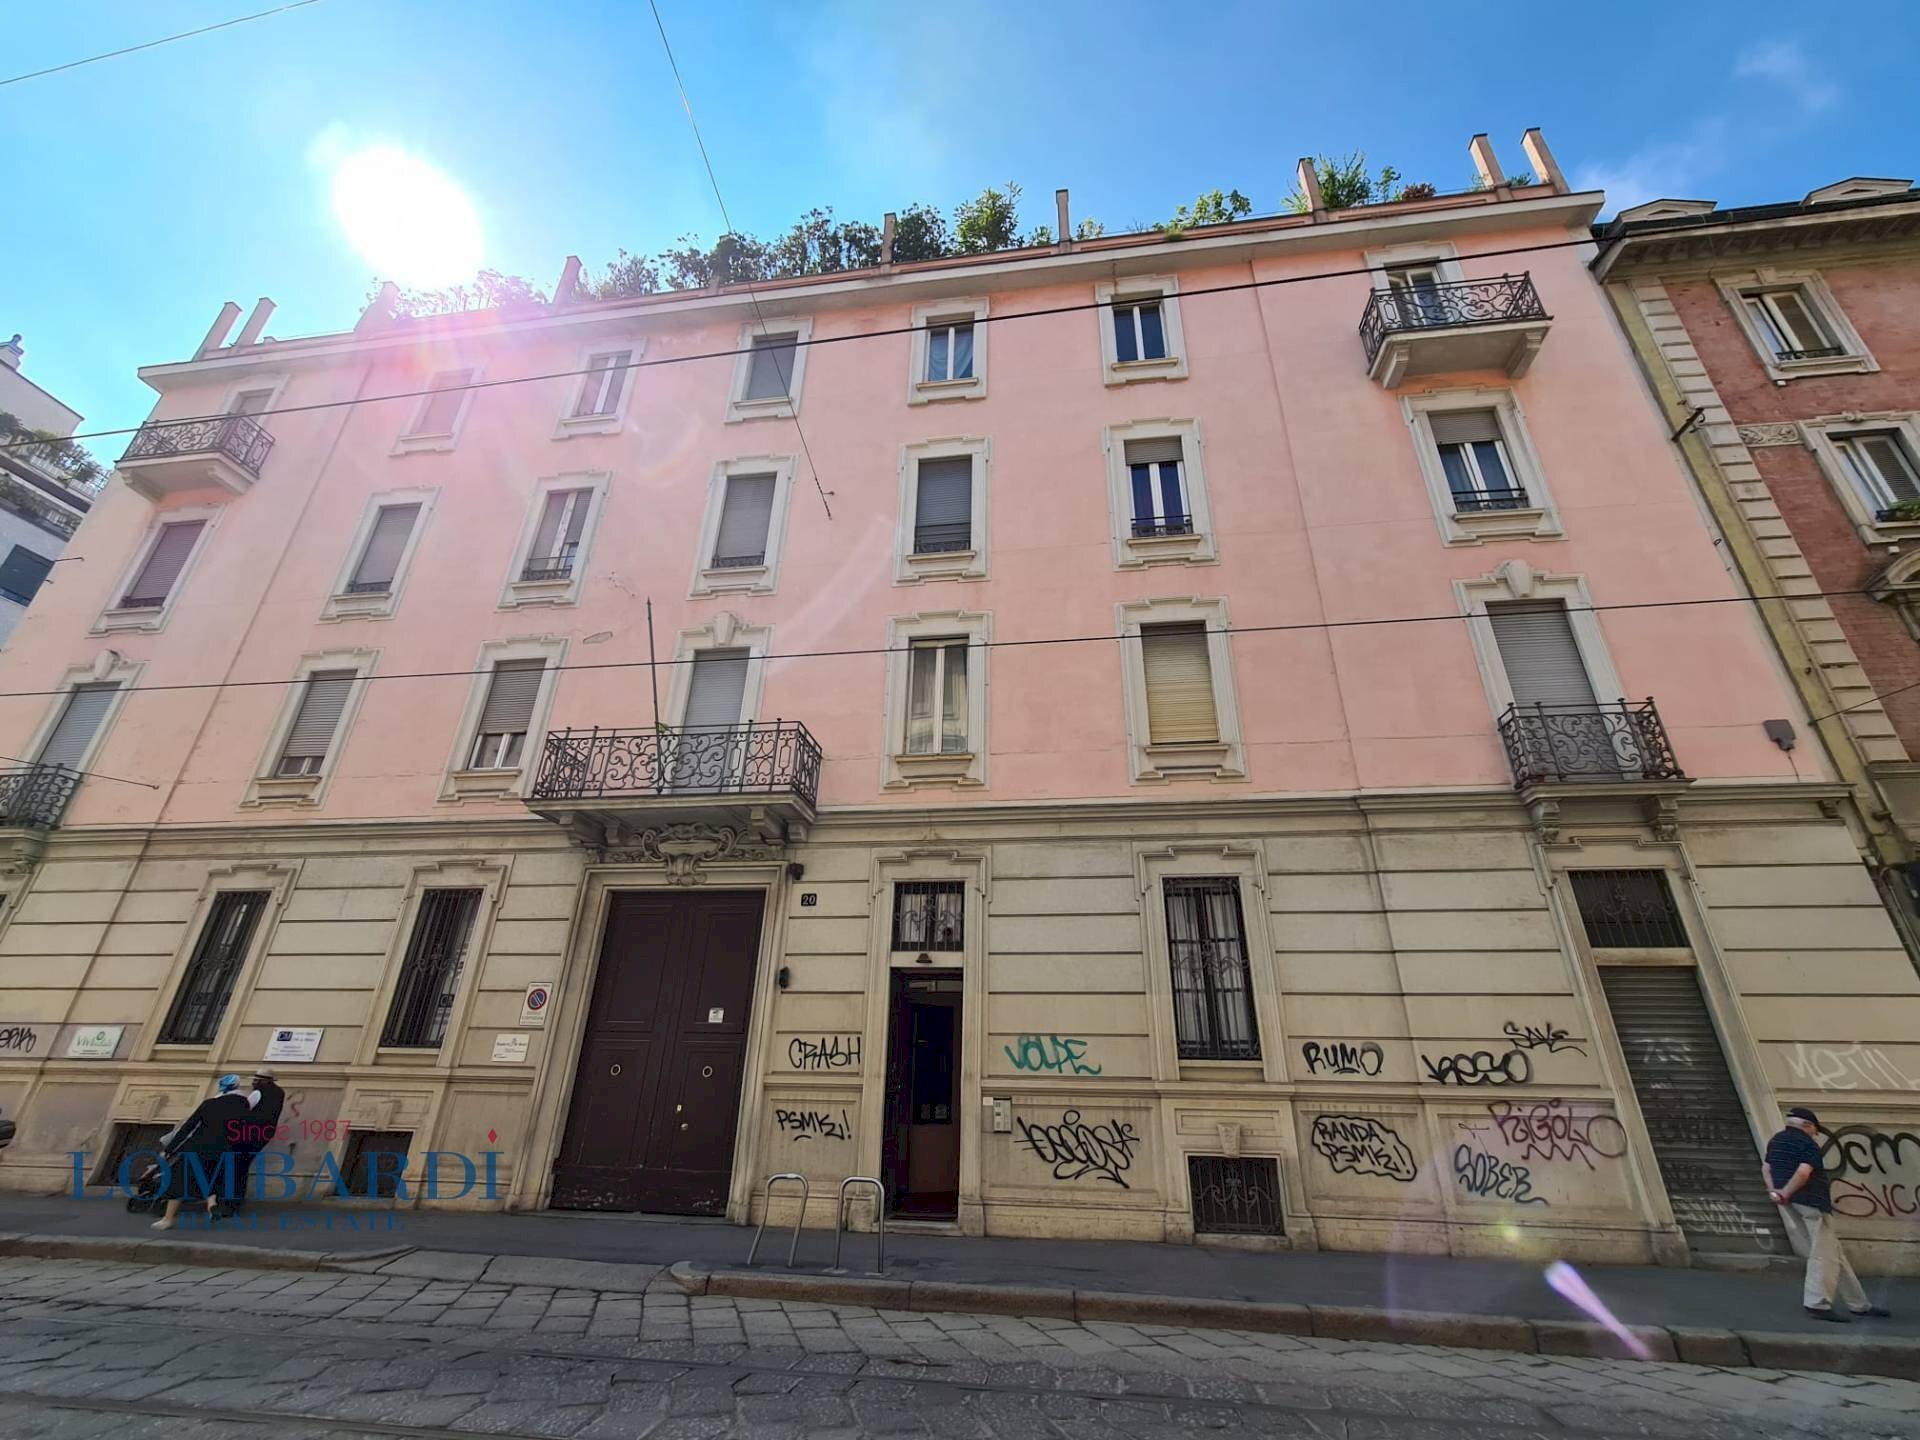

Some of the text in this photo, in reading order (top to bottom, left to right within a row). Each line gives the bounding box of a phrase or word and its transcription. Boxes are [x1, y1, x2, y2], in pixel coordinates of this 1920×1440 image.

[803, 894, 816, 905] 20
[788, 1036, 861, 1070] CRASH
[1302, 1041, 1384, 1075] RUMO
[1455, 1144, 1551, 1206] SOBER
